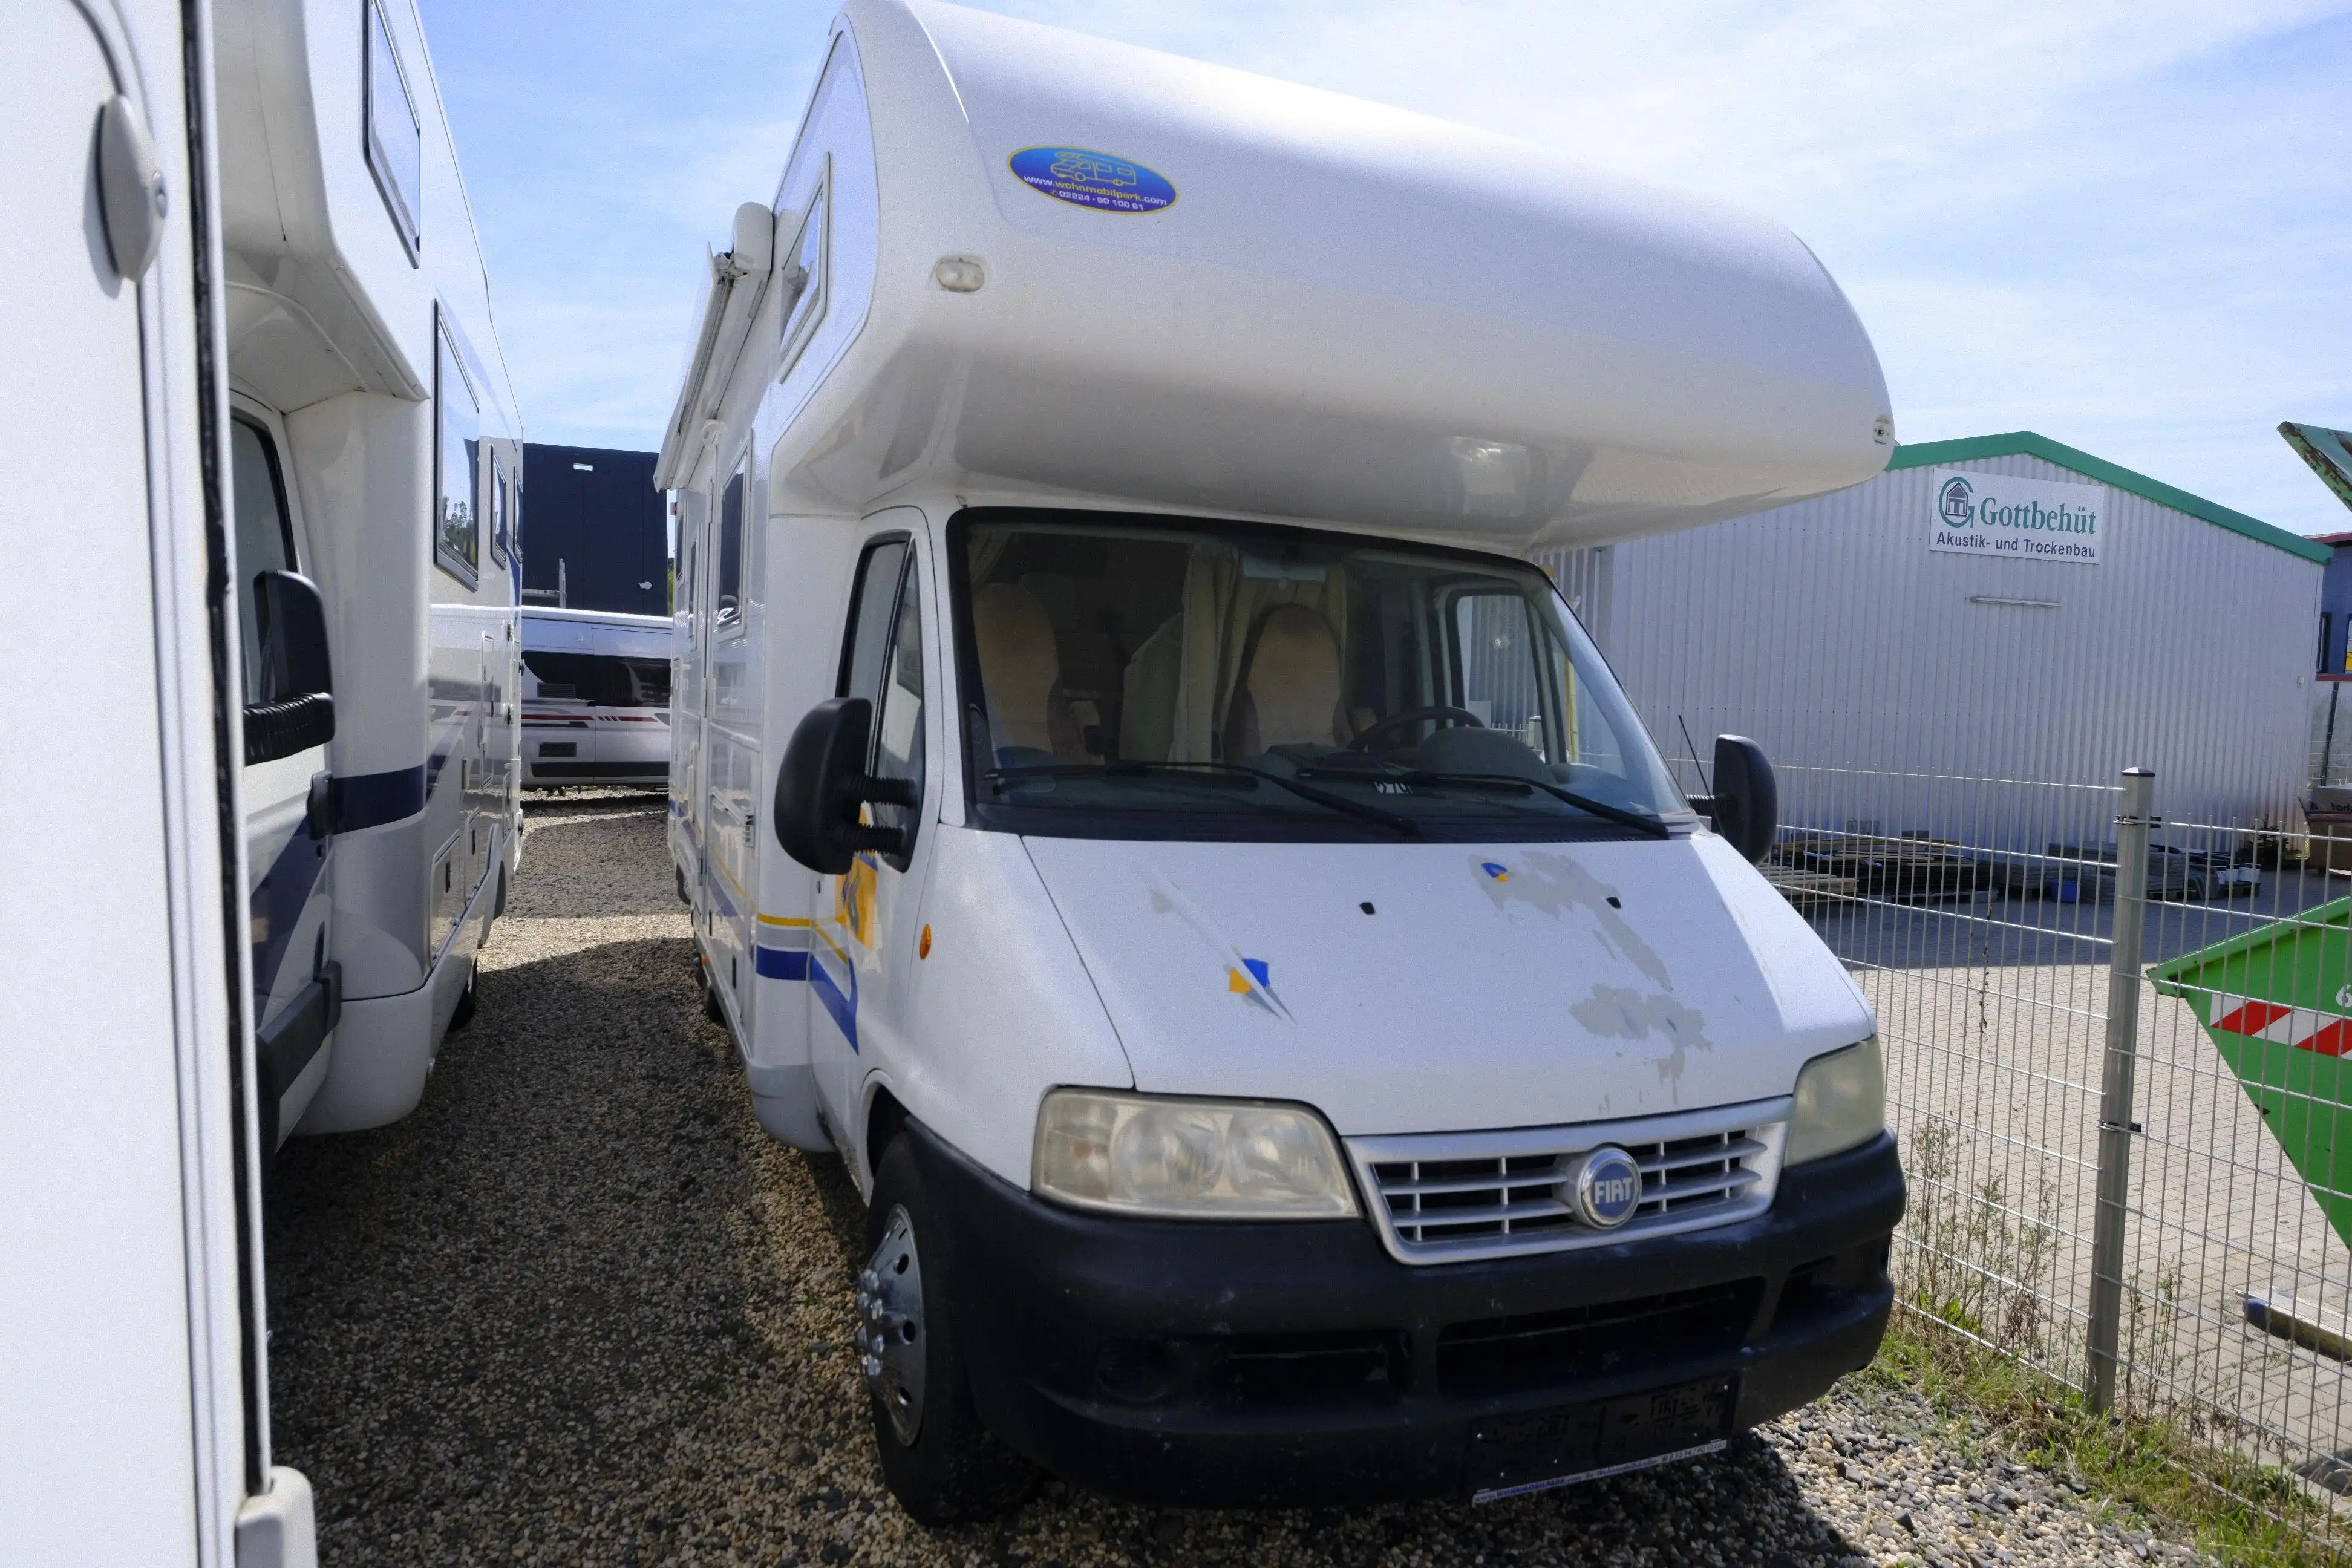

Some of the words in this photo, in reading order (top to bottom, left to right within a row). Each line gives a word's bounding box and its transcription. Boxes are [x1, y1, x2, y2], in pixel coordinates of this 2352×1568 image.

[1023, 175, 1167, 206] www.wohnmobilpark.com
[1059, 191, 1090, 201] 02224
[1097, 197, 1109, 205] 90
[1112, 199, 1130, 209] 100
[1980, 497, 2097, 535] Gottbehüt
[1936, 531, 1990, 549] Akustik-
[1995, 538, 2018, 551] und
[2024, 538, 2095, 558] Trockenbau
[1594, 1177, 1633, 1204] FIAT
